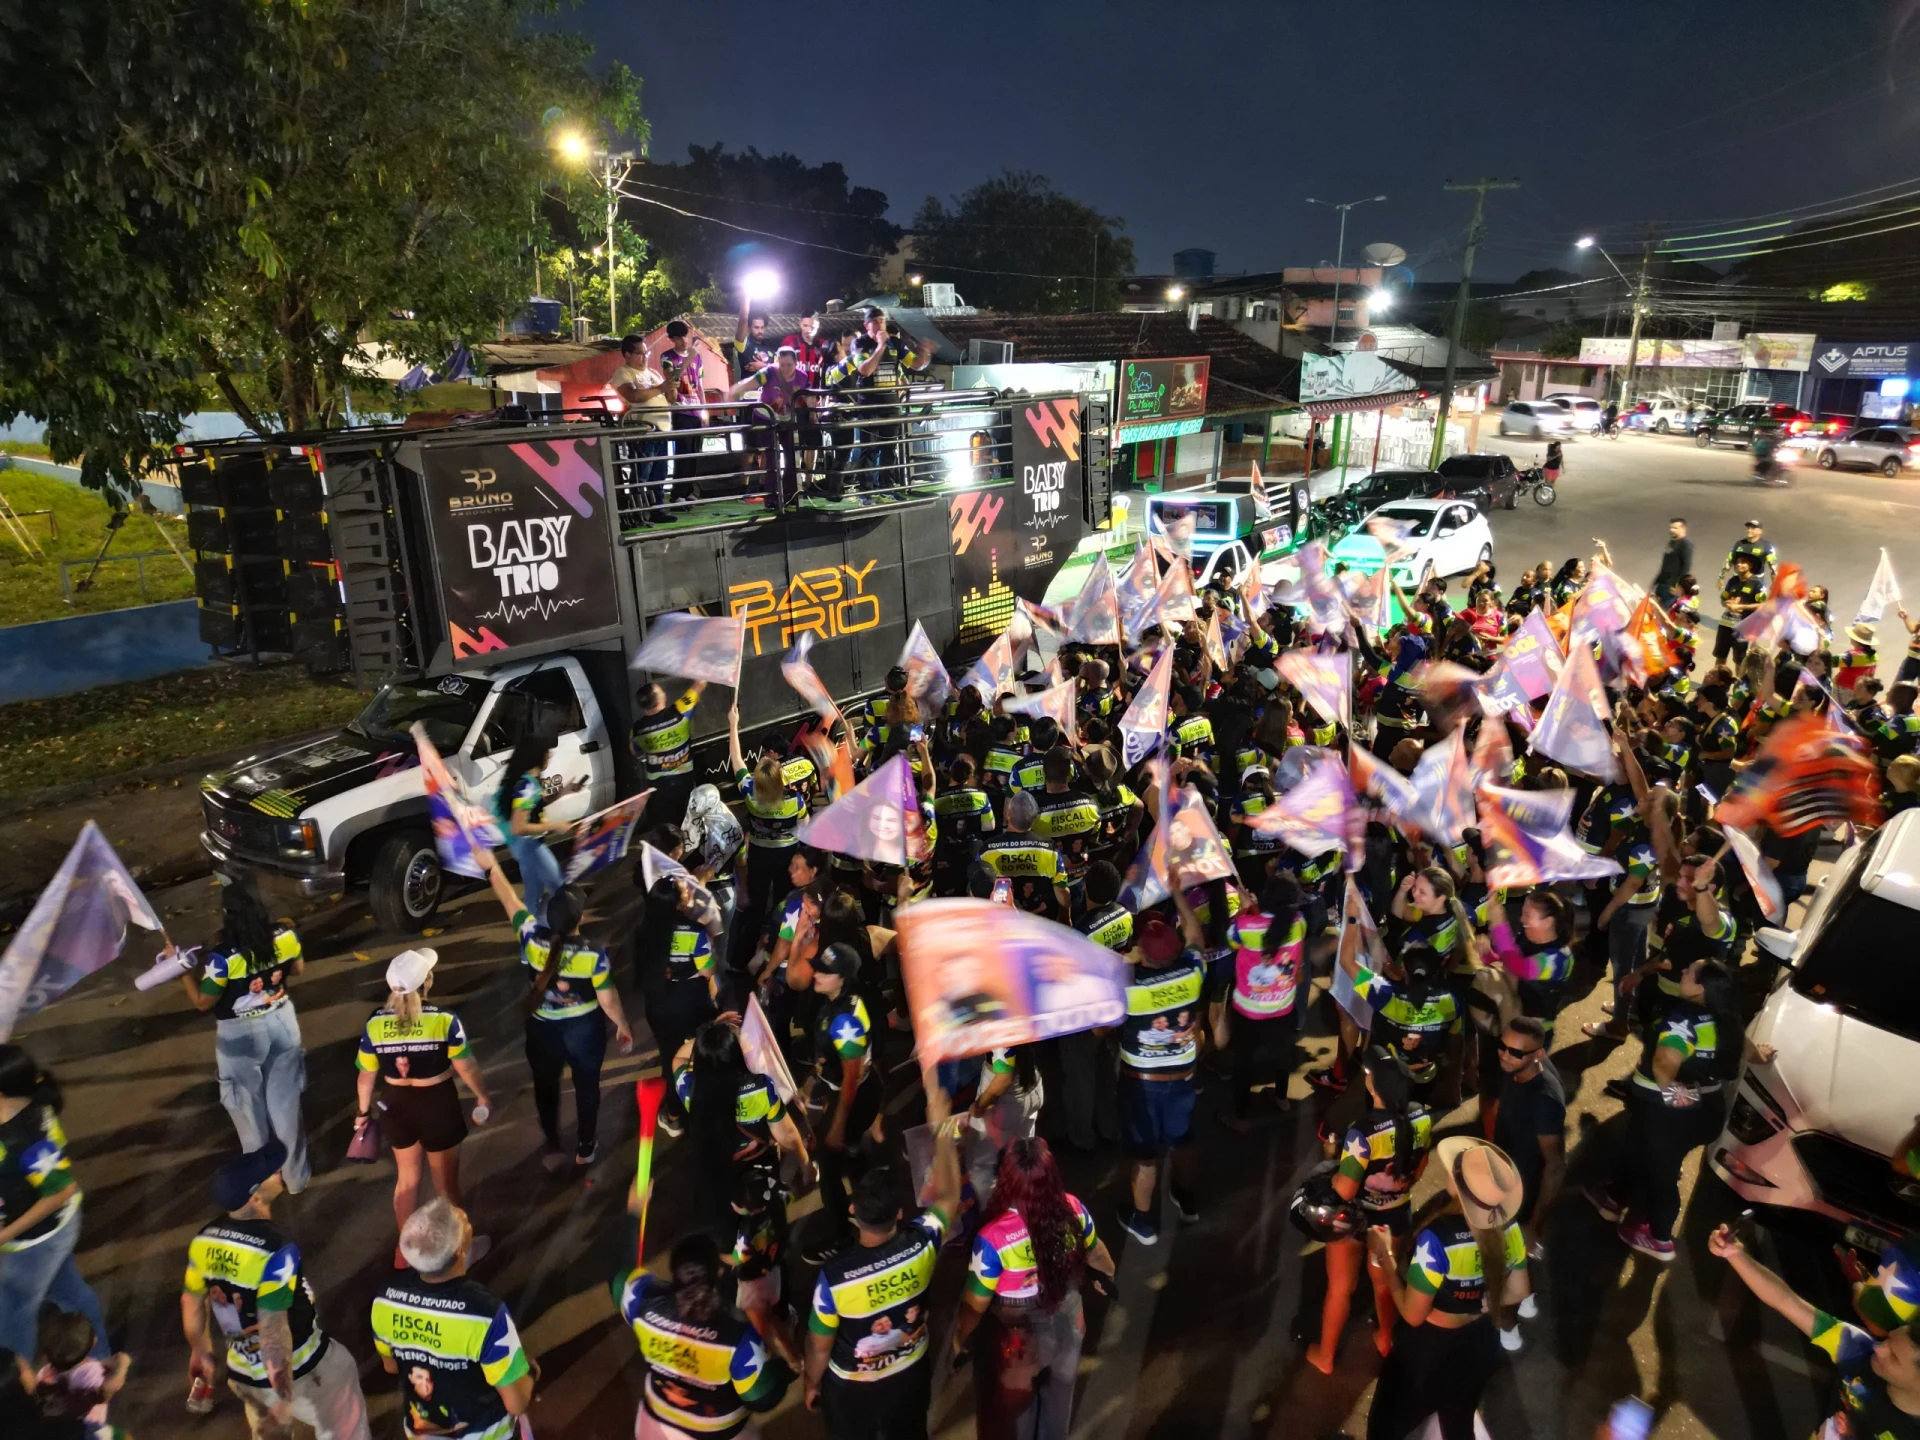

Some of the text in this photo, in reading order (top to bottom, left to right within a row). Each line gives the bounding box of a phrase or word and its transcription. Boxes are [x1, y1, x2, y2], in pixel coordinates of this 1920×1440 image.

[1852, 346, 1908, 357] APTUS
[1023, 461, 1067, 494] BABY
[449, 492, 513, 509] BRUNO
[1032, 491, 1060, 513] TRIO
[467, 515, 572, 569] BABY
[1024, 551, 1053, 564] BRUNO
[493, 561, 559, 598] TRIO
[729, 559, 878, 619] BABY
[744, 594, 880, 656] TRIO
[437, 676, 469, 696] SOM
[1051, 811, 1085, 826] FISCAL
[1064, 821, 1086, 830] POVO
[988, 840, 1050, 849] EQUIPE DO DEPUTADO
[1001, 853, 1038, 864] FISCAL
[1001, 862, 1038, 872] DO POVO
[1102, 922, 1126, 941] FISCAL
[1150, 983, 1190, 1000] FISCAL
[407, 1043, 440, 1053] MENDES
[1373, 1119, 1394, 1131] EQUIPE
[206, 1247, 241, 1267] FISCAL
[844, 1242, 922, 1280] EQUIPE DO DEPUTADO
[866, 1268, 918, 1297] FISCAL
[385, 1287, 466, 1311] EQUIPE DO DEPUTADO
[869, 1280, 920, 1308] DO POVO
[392, 1313, 442, 1337] FISCAL
[392, 1329, 442, 1350] DO POVO
[650, 1337, 699, 1362] FISCAL
